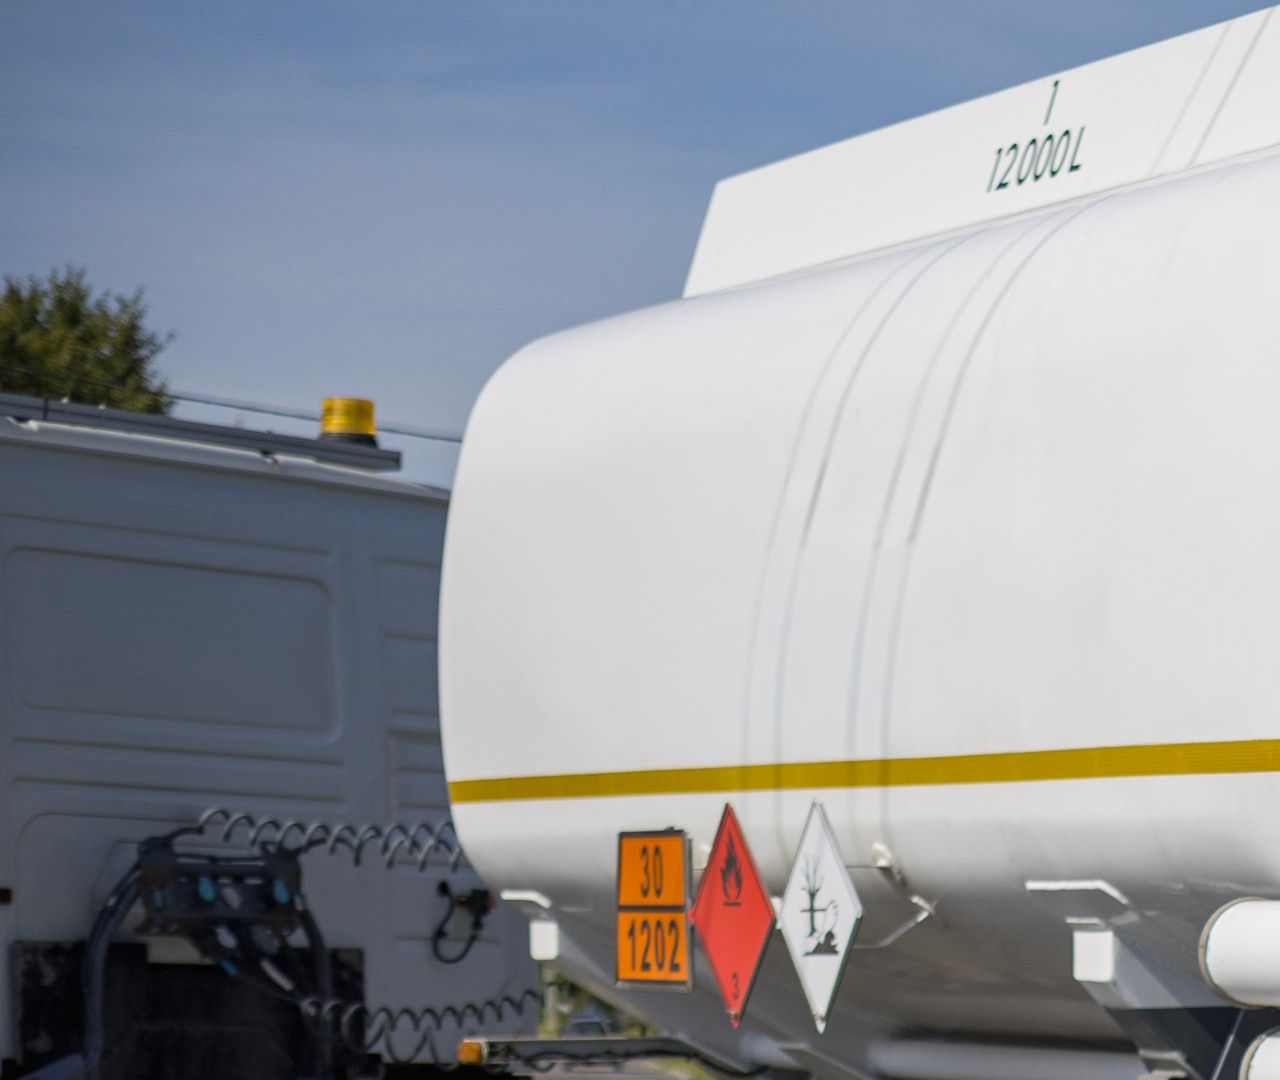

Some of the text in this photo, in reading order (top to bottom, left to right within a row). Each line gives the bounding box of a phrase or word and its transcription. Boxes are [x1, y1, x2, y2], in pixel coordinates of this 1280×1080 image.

[1043, 80, 1060, 126] 1
[986, 126, 1086, 193] 12000L
[639, 844, 664, 898] 30
[627, 918, 681, 973] 1202
[731, 973, 740, 1000] 3
